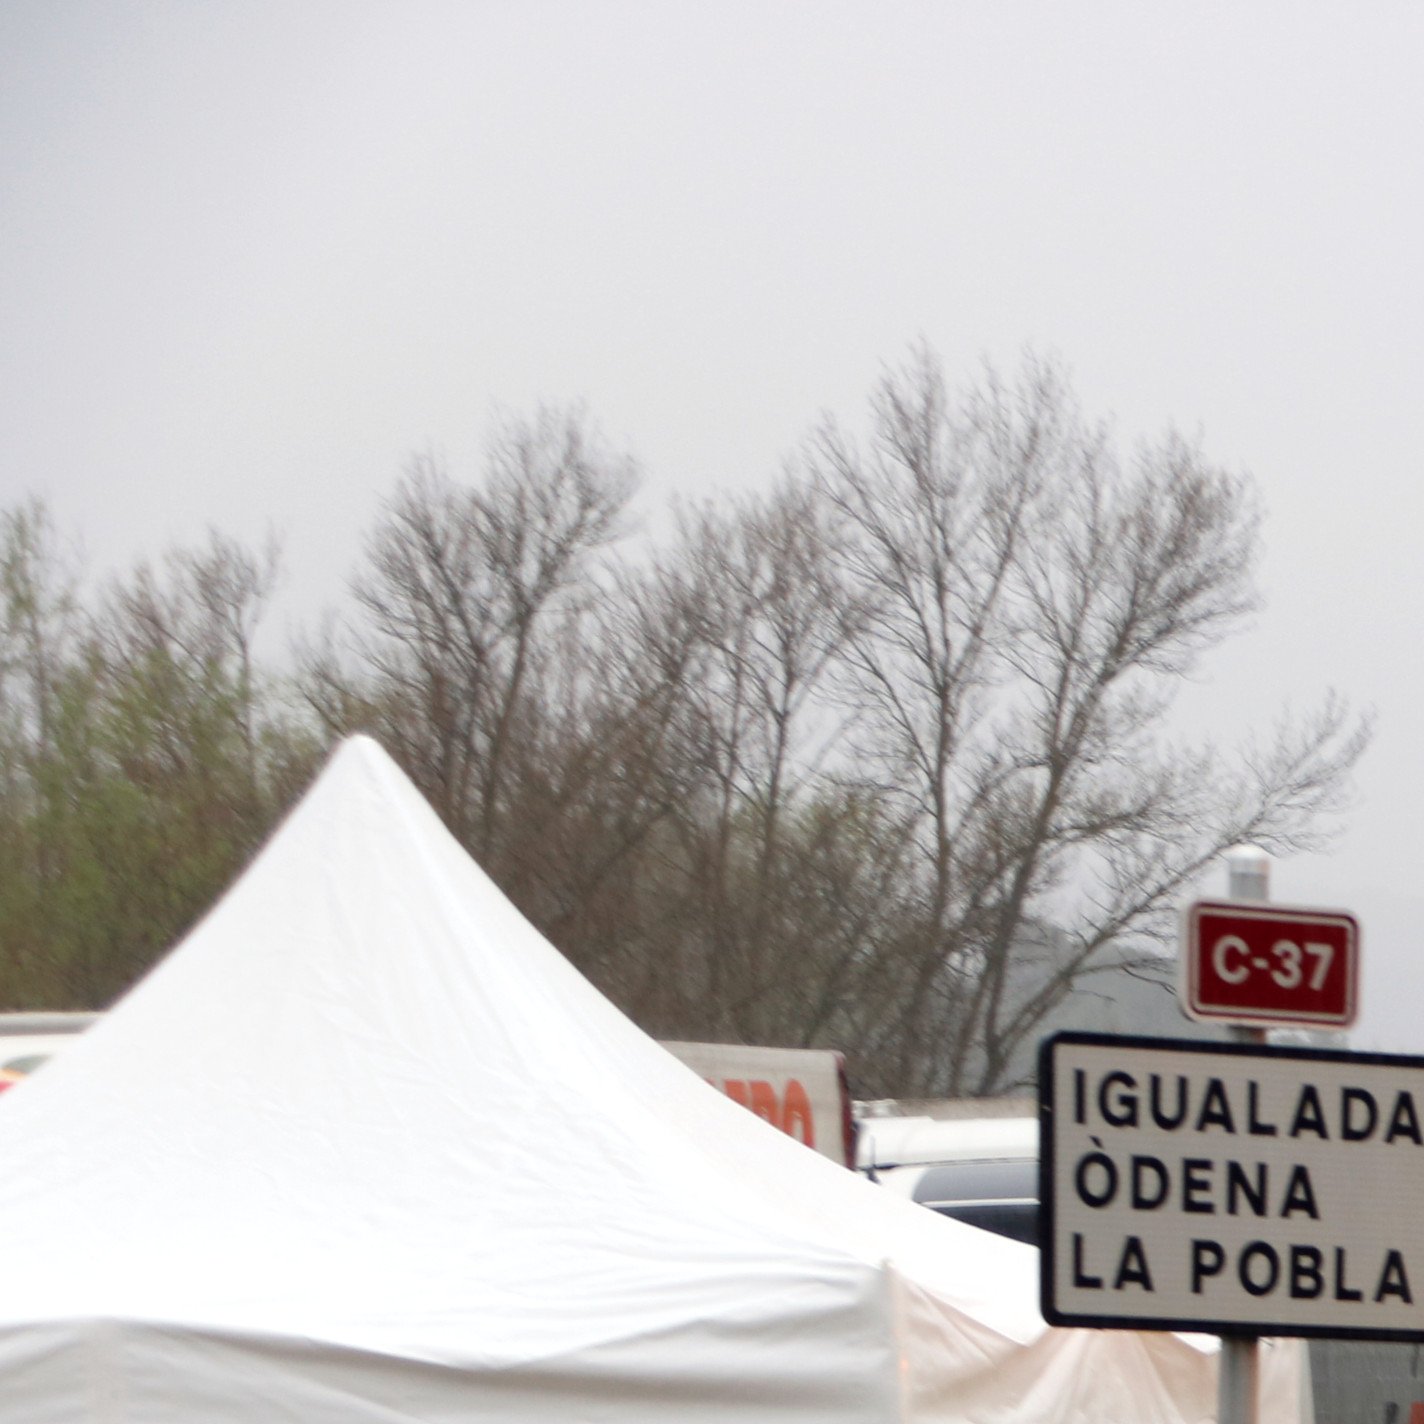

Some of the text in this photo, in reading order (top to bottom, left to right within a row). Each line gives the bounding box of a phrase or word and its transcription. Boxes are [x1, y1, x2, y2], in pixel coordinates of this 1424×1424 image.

[1211, 935, 1336, 991] C-37
[1073, 1068, 1424, 1146] IGUALADA
[1075, 1137, 1321, 1220] ÒDENA
[1073, 1233, 1154, 1293] LA
[1192, 1240, 1414, 1305] POBLA
